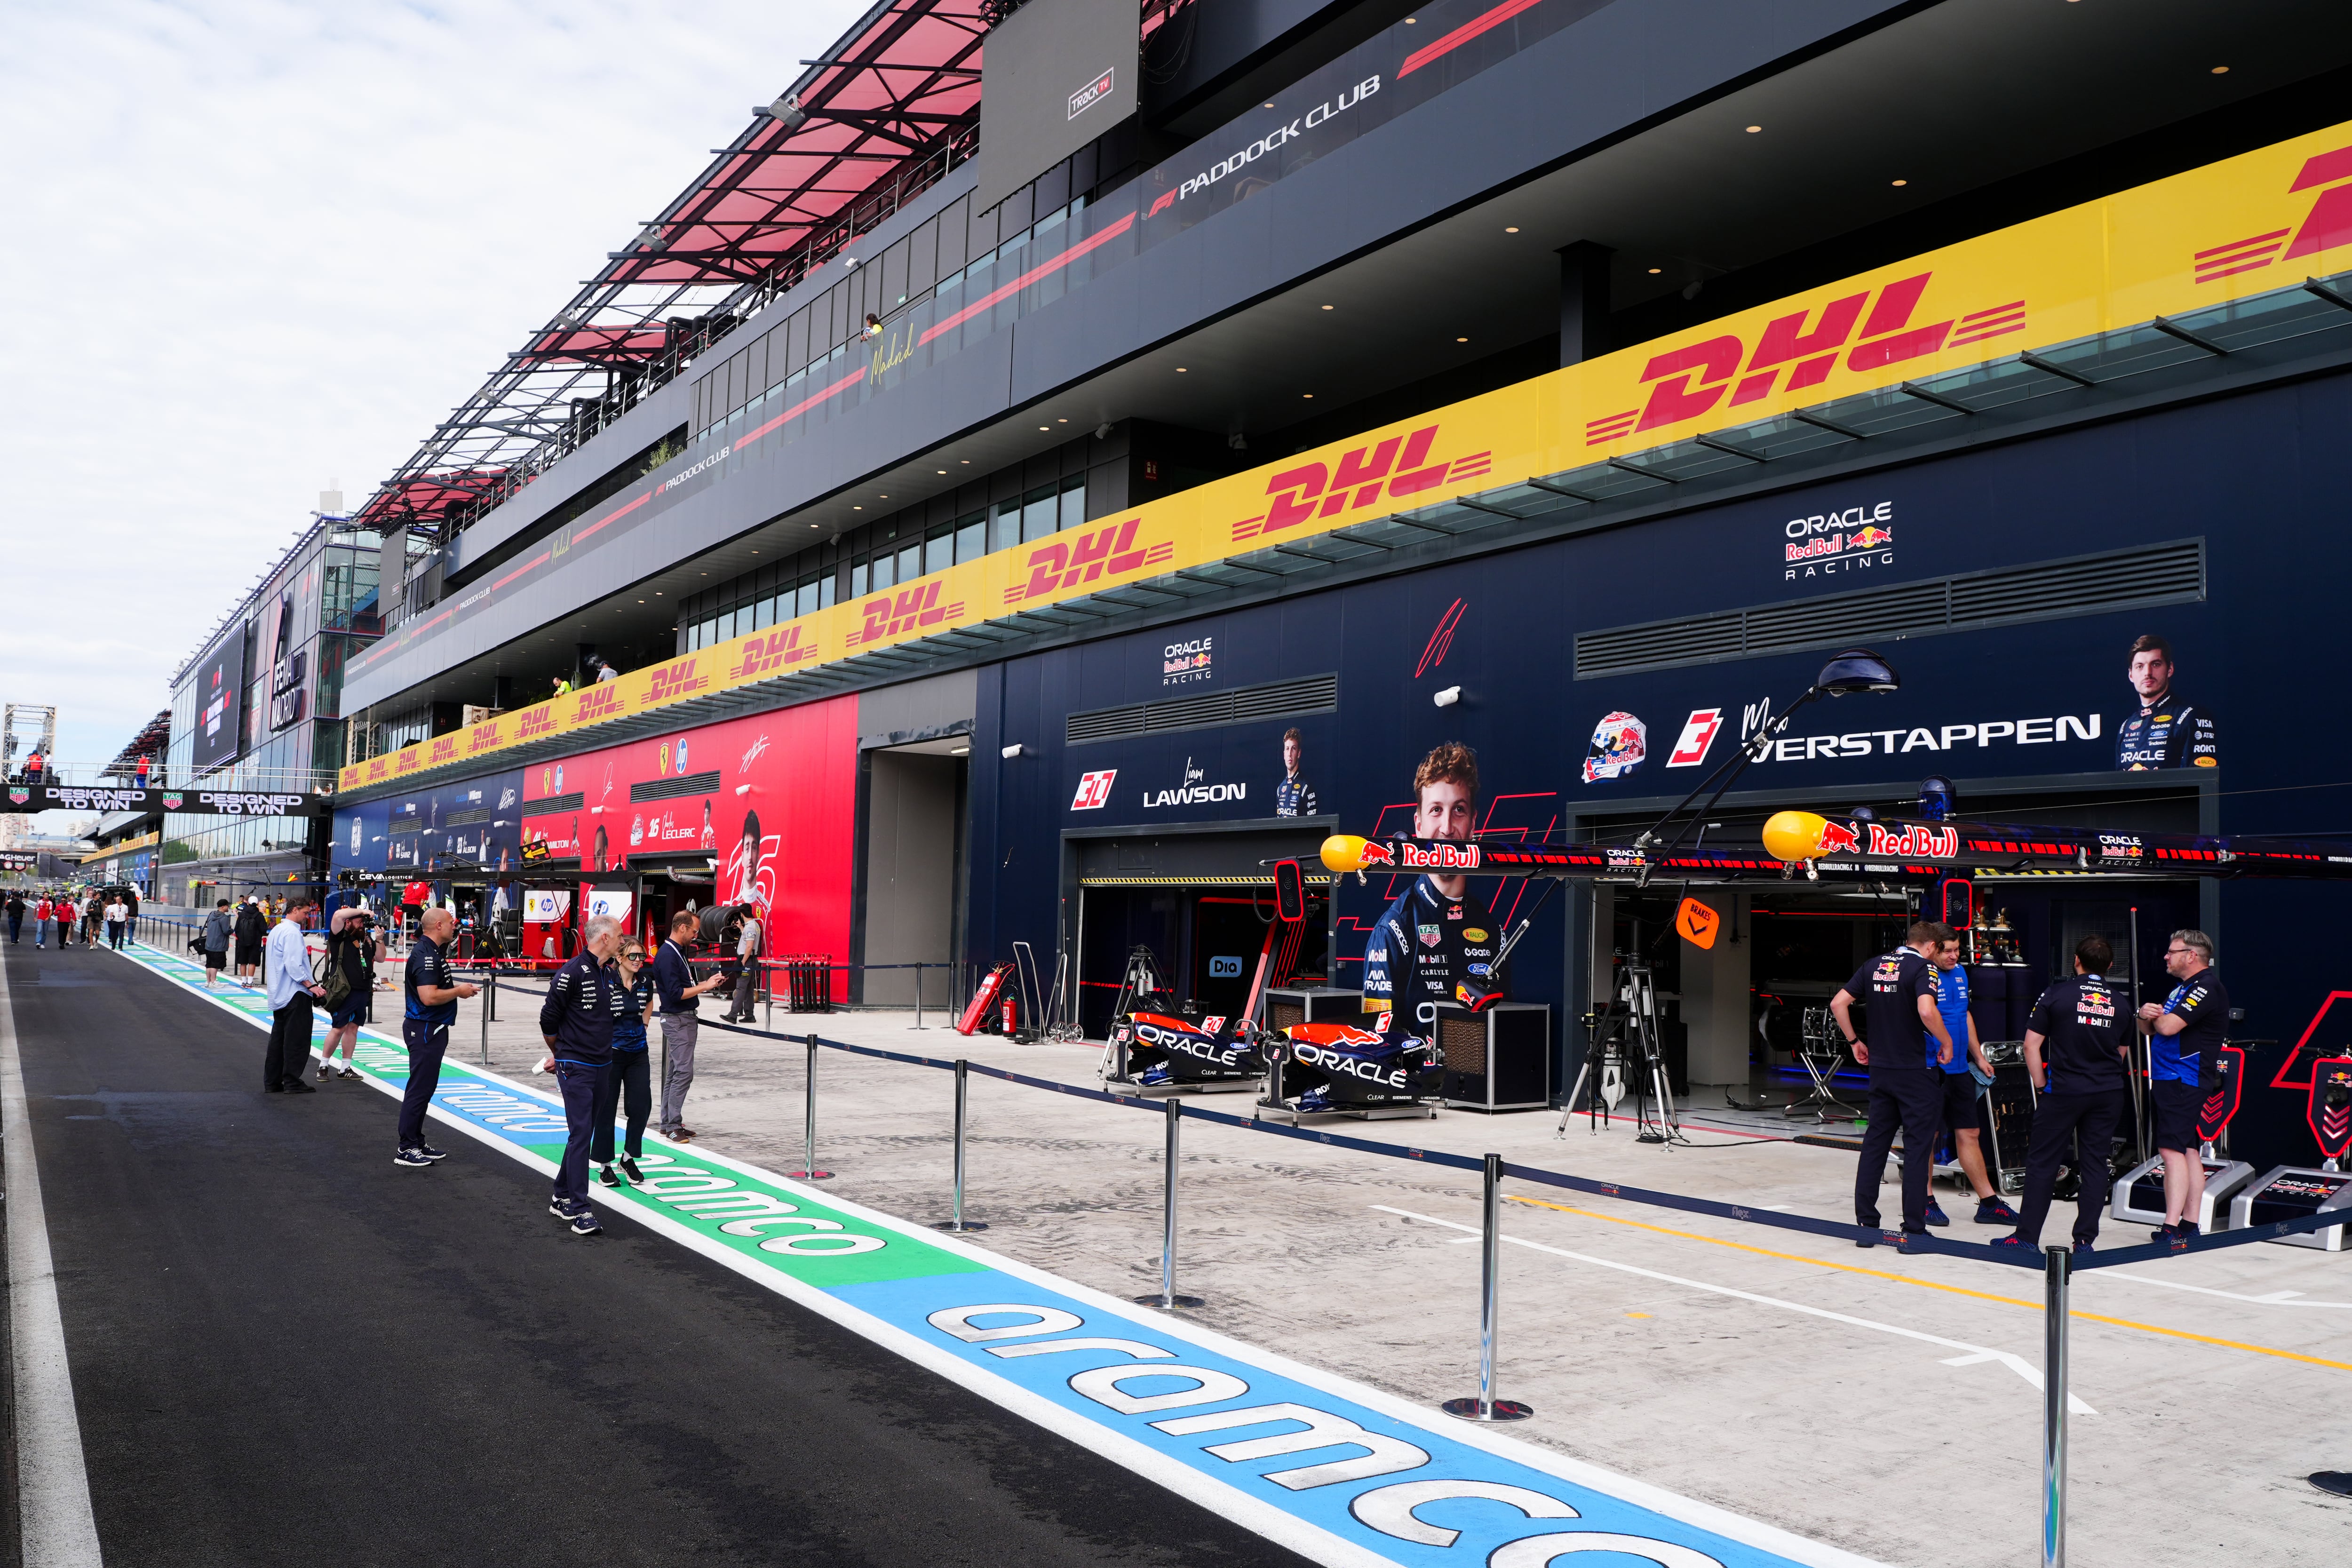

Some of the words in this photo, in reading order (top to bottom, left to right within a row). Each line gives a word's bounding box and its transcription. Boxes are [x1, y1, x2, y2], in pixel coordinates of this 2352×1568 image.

[1072, 83, 1099, 111] TRACK
[1100, 79, 1109, 91] TV
[1180, 118, 1301, 200] PADDOCK
[1305, 74, 1381, 128] CLUB
[870, 322, 914, 385] Madrid
[1633, 271, 1955, 433] DHL
[666, 459, 706, 491] PADDOCK
[706, 446, 729, 467] CLUB
[1262, 424, 1451, 534] DHL
[1786, 501, 1892, 538] ORACLE
[1024, 517, 1148, 599] DHL
[1785, 552, 1893, 581] RACING
[460, 593, 479, 610] PADDOCK
[479, 586, 490, 599] CLUB
[860, 580, 947, 644] DHL
[740, 625, 805, 681] DHL
[1164, 637, 1212, 658] ORACLE
[274, 653, 293, 695] IFEMA
[649, 658, 699, 702] DHL
[1163, 670, 1211, 686] RACING
[271, 687, 296, 731] MADRID
[577, 684, 617, 723] DHL
[519, 705, 553, 738] DHL
[2195, 718, 2213, 729] VISA
[470, 722, 499, 753] DHL
[1742, 713, 2101, 764] VERSTAPPEN
[431, 737, 455, 764] DHL
[2121, 750, 2166, 763] ORACLE
[369, 758, 387, 782] DHL
[398, 749, 418, 773] DHL
[343, 767, 359, 788] DHL
[1184, 756, 1204, 788] Liam
[9, 794, 29, 804] HEUER
[46, 788, 146, 801] DESIGNED
[199, 793, 302, 805] DESIGNED
[1073, 772, 1115, 808] 30
[1143, 782, 1246, 808] LAWSON
[60, 798, 88, 809] TO
[92, 799, 130, 811] WIN
[163, 800, 182, 809] HEUER
[214, 803, 242, 814] TO
[247, 804, 285, 815] WIN
[648, 818, 660, 837] 16
[661, 828, 696, 839] LECLERC
[2099, 835, 2142, 846] ORACLE
[1818, 863, 1859, 871] REDBULLRACING.CM
[542, 899, 553, 911] hp
[1690, 903, 1711, 921] BRAKES
[1388, 919, 1409, 955] sparco
[1420, 934, 1441, 946] HEUER
[1367, 948, 1388, 963] Mobil
[1419, 955, 1440, 963] Mobil
[1471, 947, 1491, 957] Gate
[1215, 960, 1237, 973] Dia
[1368, 970, 1386, 980] AVA
[1472, 964, 1487, 973] Ford
[1425, 981, 1444, 990] VISA
[2079, 985, 2112, 995] ORACLE
[1202, 1017, 1224, 1032] 30
[1377, 1012, 1393, 1032] 3
[2077, 1016, 2102, 1027] Mobil
[1117, 1030, 1129, 1041] 30
[1137, 1025, 1238, 1067] ORACLE
[1403, 1044, 1426, 1055] RACING
[1294, 1043, 1407, 1089] ORACLE
[2265, 1187, 2330, 1199] RACING
[2276, 1179, 2341, 1190] ORACLE
[589, 1153, 888, 1257] aramco
[1732, 1206, 1750, 1220] flex
[1883, 1229, 1907, 1238] ORACLE
